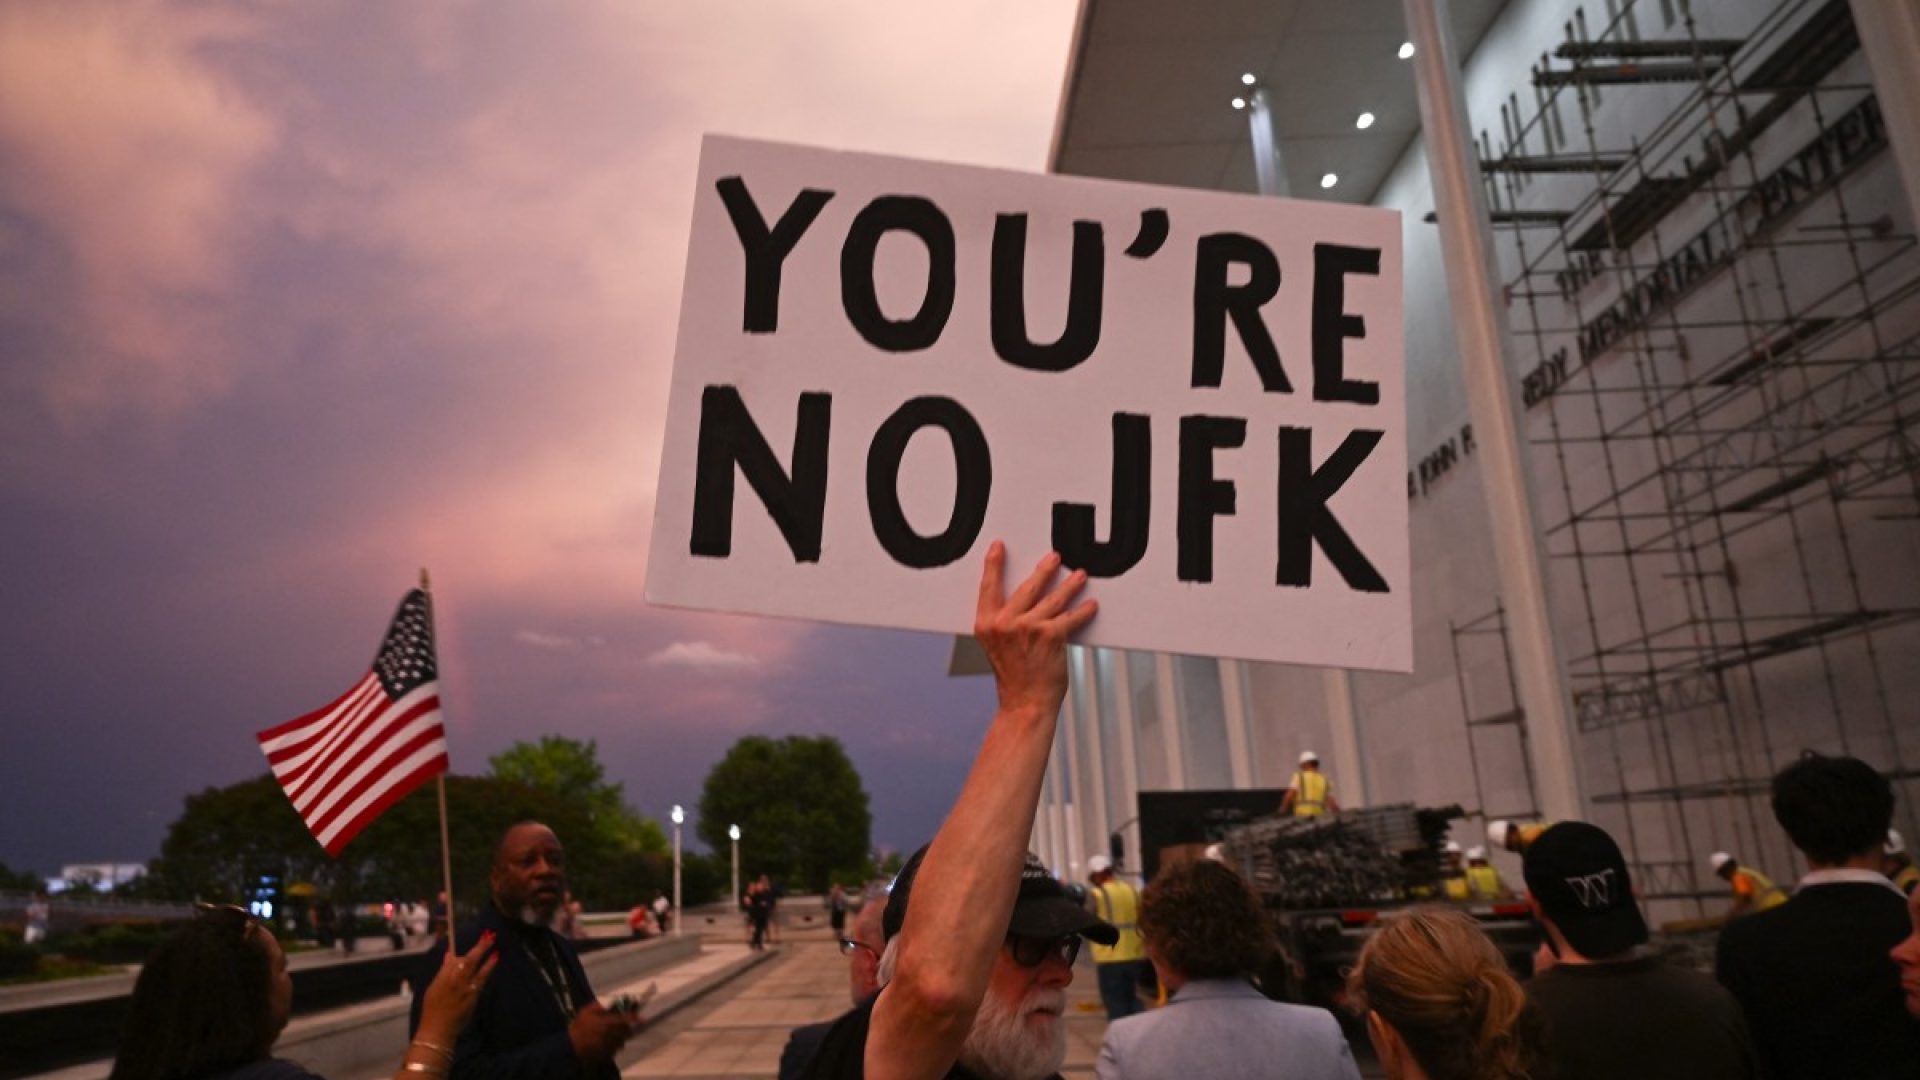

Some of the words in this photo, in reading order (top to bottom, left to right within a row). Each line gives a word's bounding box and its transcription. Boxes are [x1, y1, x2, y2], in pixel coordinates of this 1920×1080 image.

[715, 175, 1381, 405] YOU'RE
[689, 383, 993, 569] NO
[1052, 411, 1391, 593] JFK
